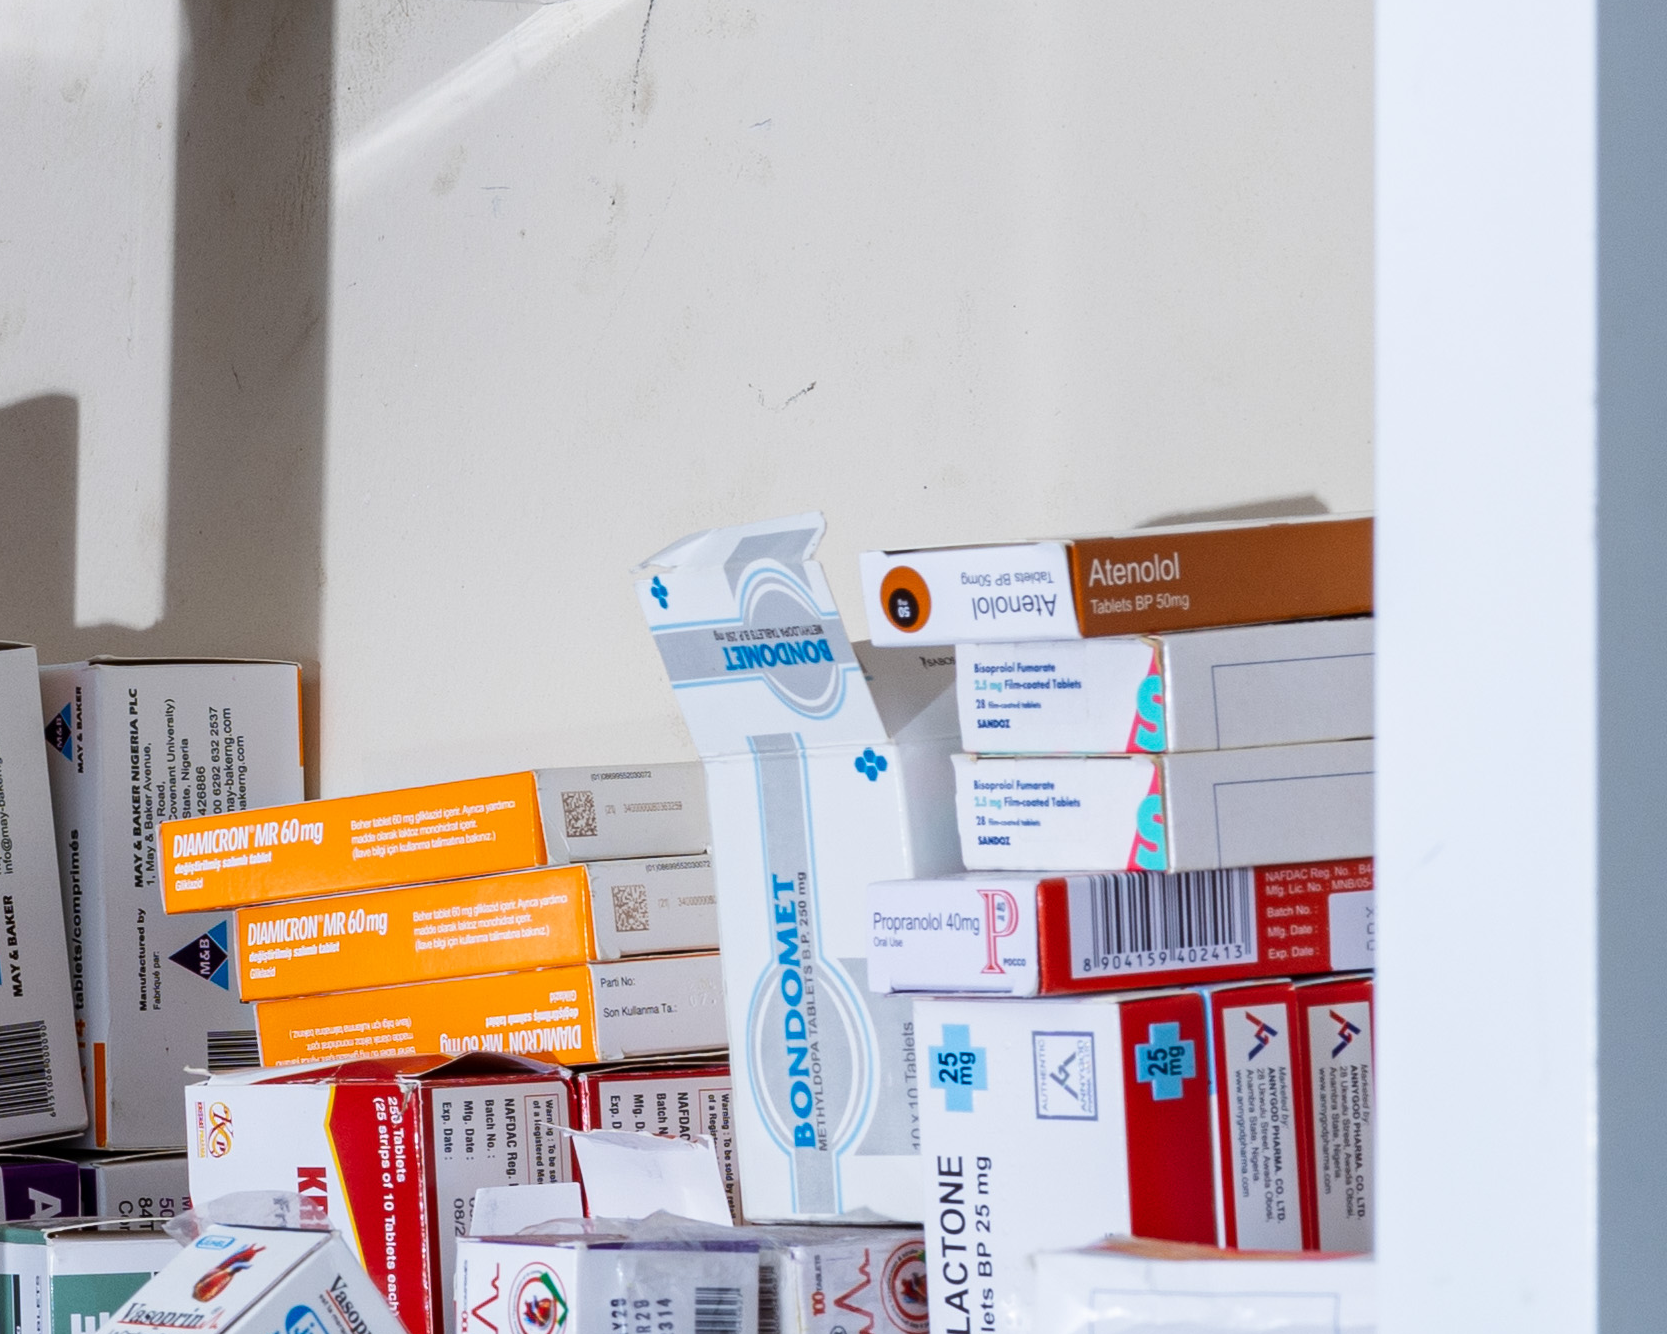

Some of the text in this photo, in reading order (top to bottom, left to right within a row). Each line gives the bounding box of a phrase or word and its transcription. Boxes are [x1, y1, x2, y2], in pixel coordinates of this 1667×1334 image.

[1089, 551, 1180, 587] Atenolol
[971, 592, 1057, 621] Atenolol
[1090, 592, 1190, 614] Tablets BP 50mg
[723, 642, 834, 672] BONDOMET
[973, 661, 1056, 674] Bisoprolol Fumarate
[977, 718, 1011, 729] SANDOZ
[255, 823, 278, 851] MR
[280, 820, 298, 848] 60
[299, 822, 324, 847] mg
[872, 911, 980, 935] Propranolol 40mg
[770, 872, 817, 1150] BONDOMET
[804, 956, 829, 1152] METHYLDOPA TABLETS
[939, 1051, 959, 1084] 25
[960, 1050, 976, 1087] mg
[117, 1301, 206, 1333] Vasoprin
